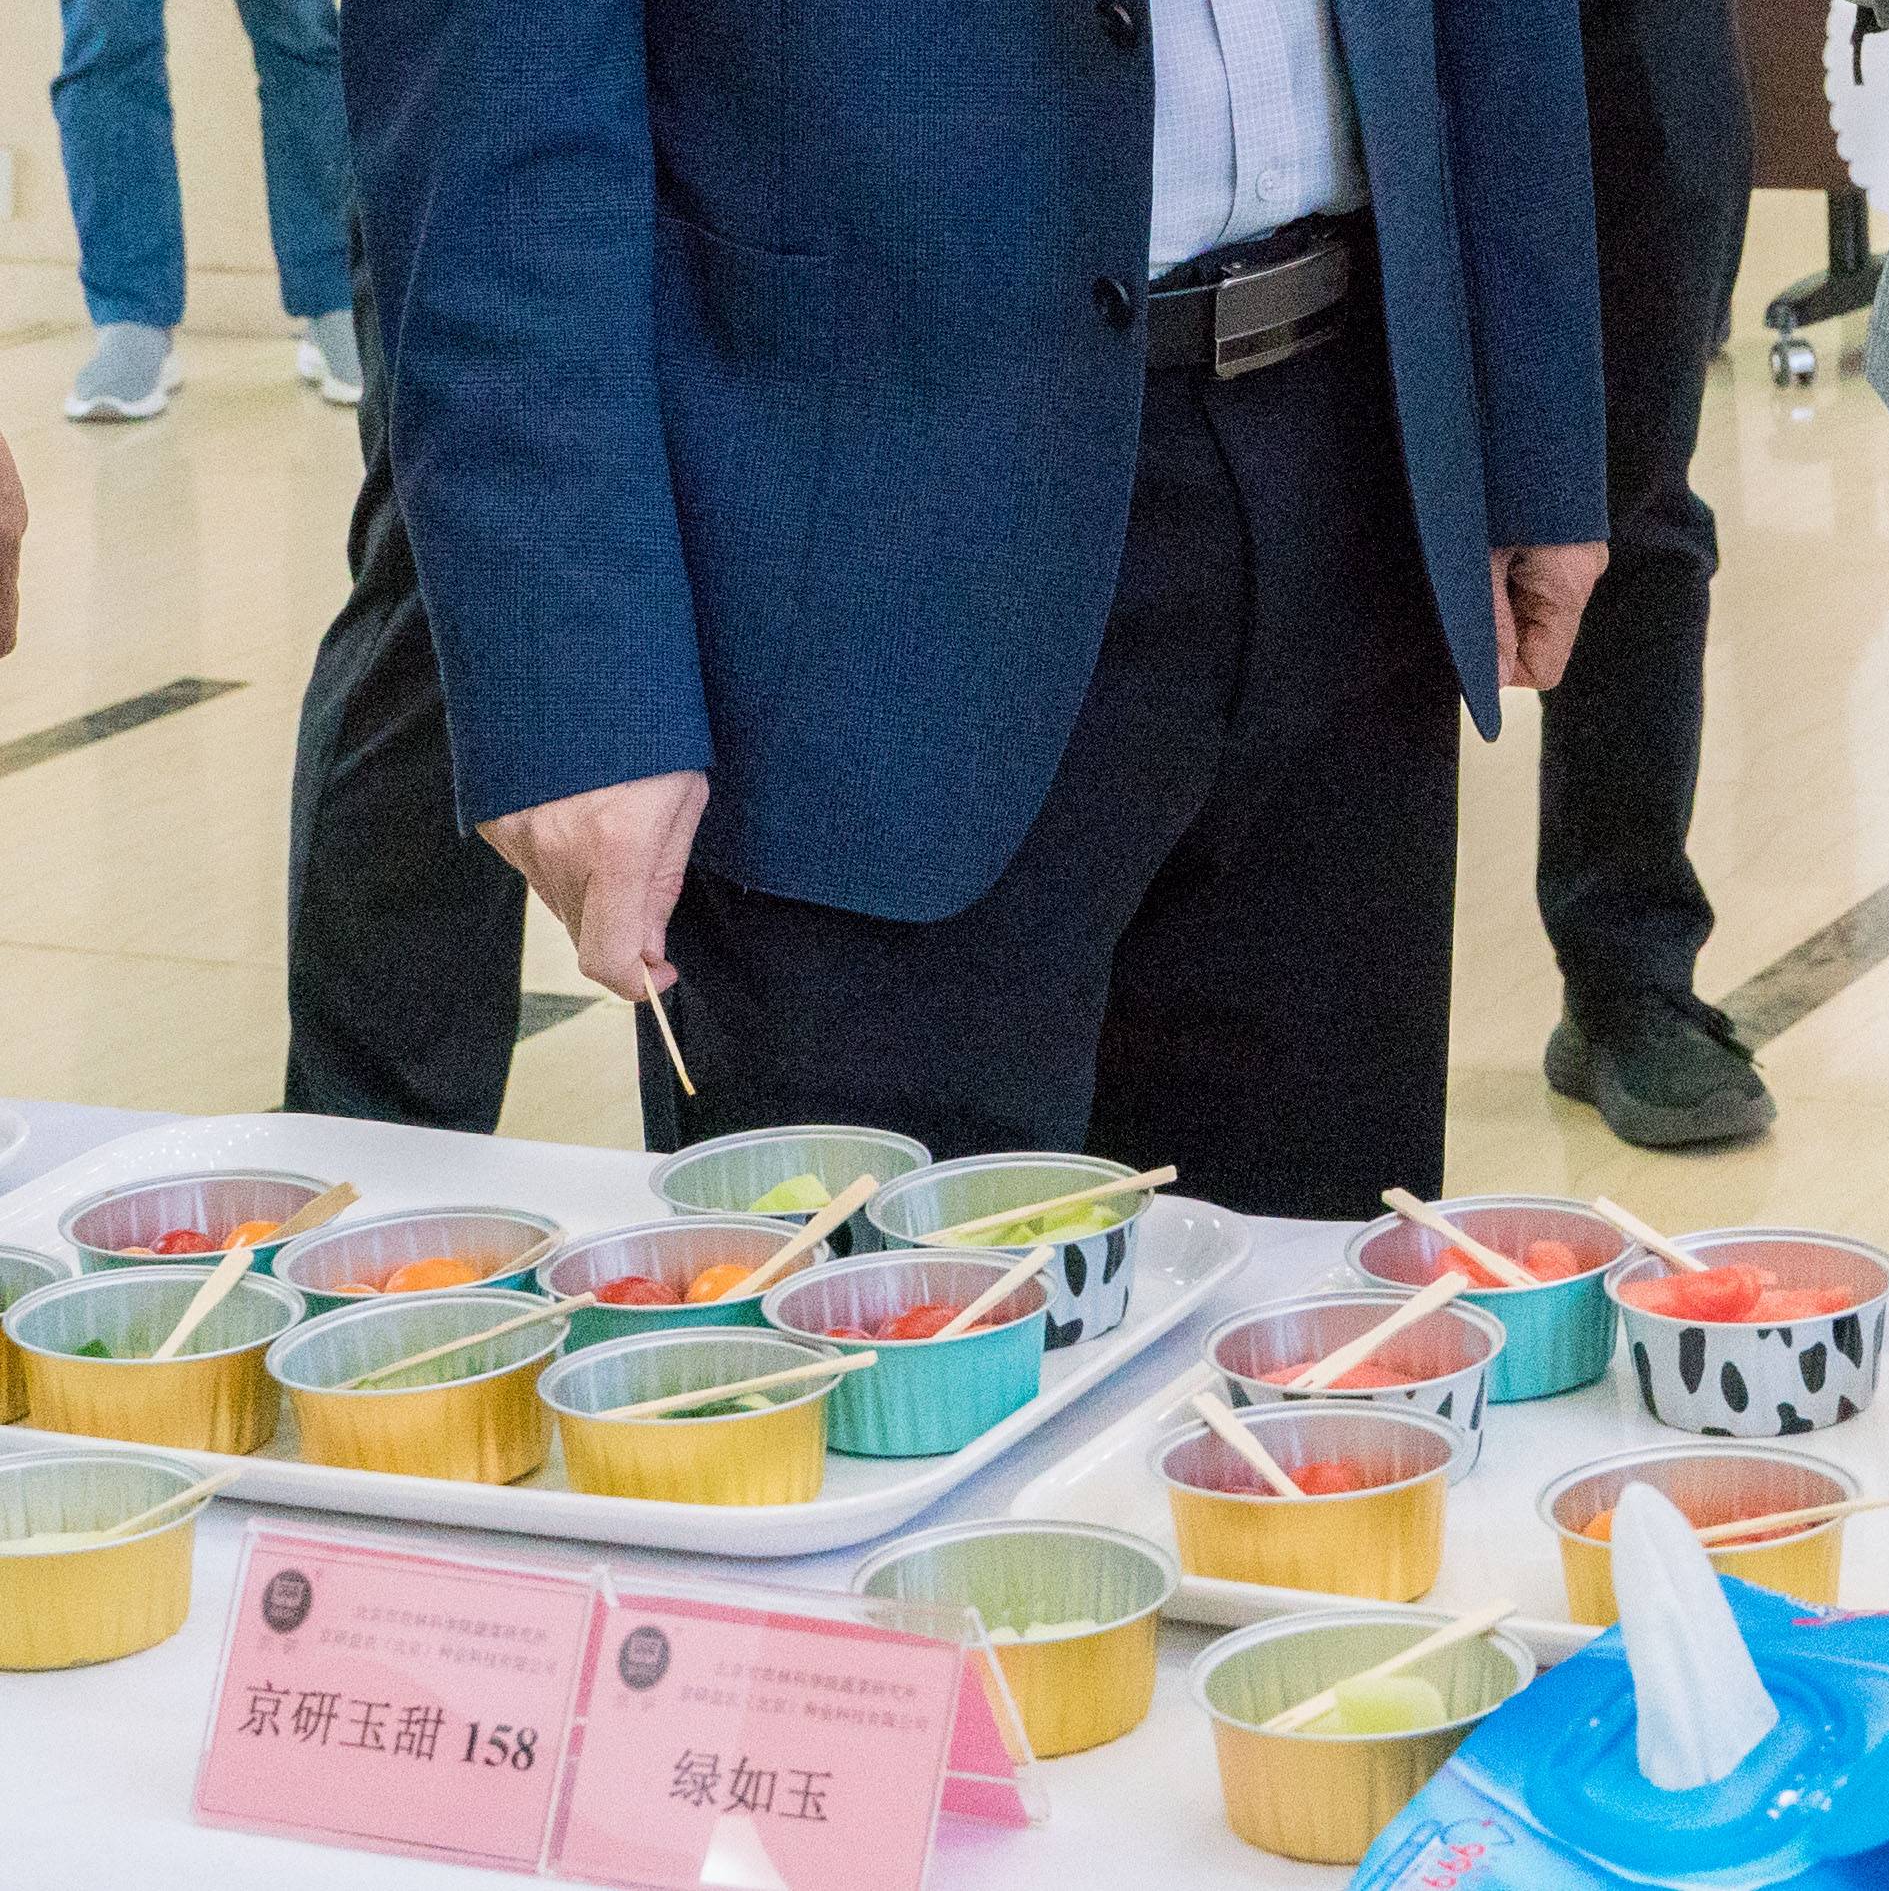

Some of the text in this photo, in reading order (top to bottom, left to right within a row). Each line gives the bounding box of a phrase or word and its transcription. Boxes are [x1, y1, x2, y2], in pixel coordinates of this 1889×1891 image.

[239, 1680, 539, 1771] 京研玉甜 158
[669, 1748, 833, 1821] 绿如玉
